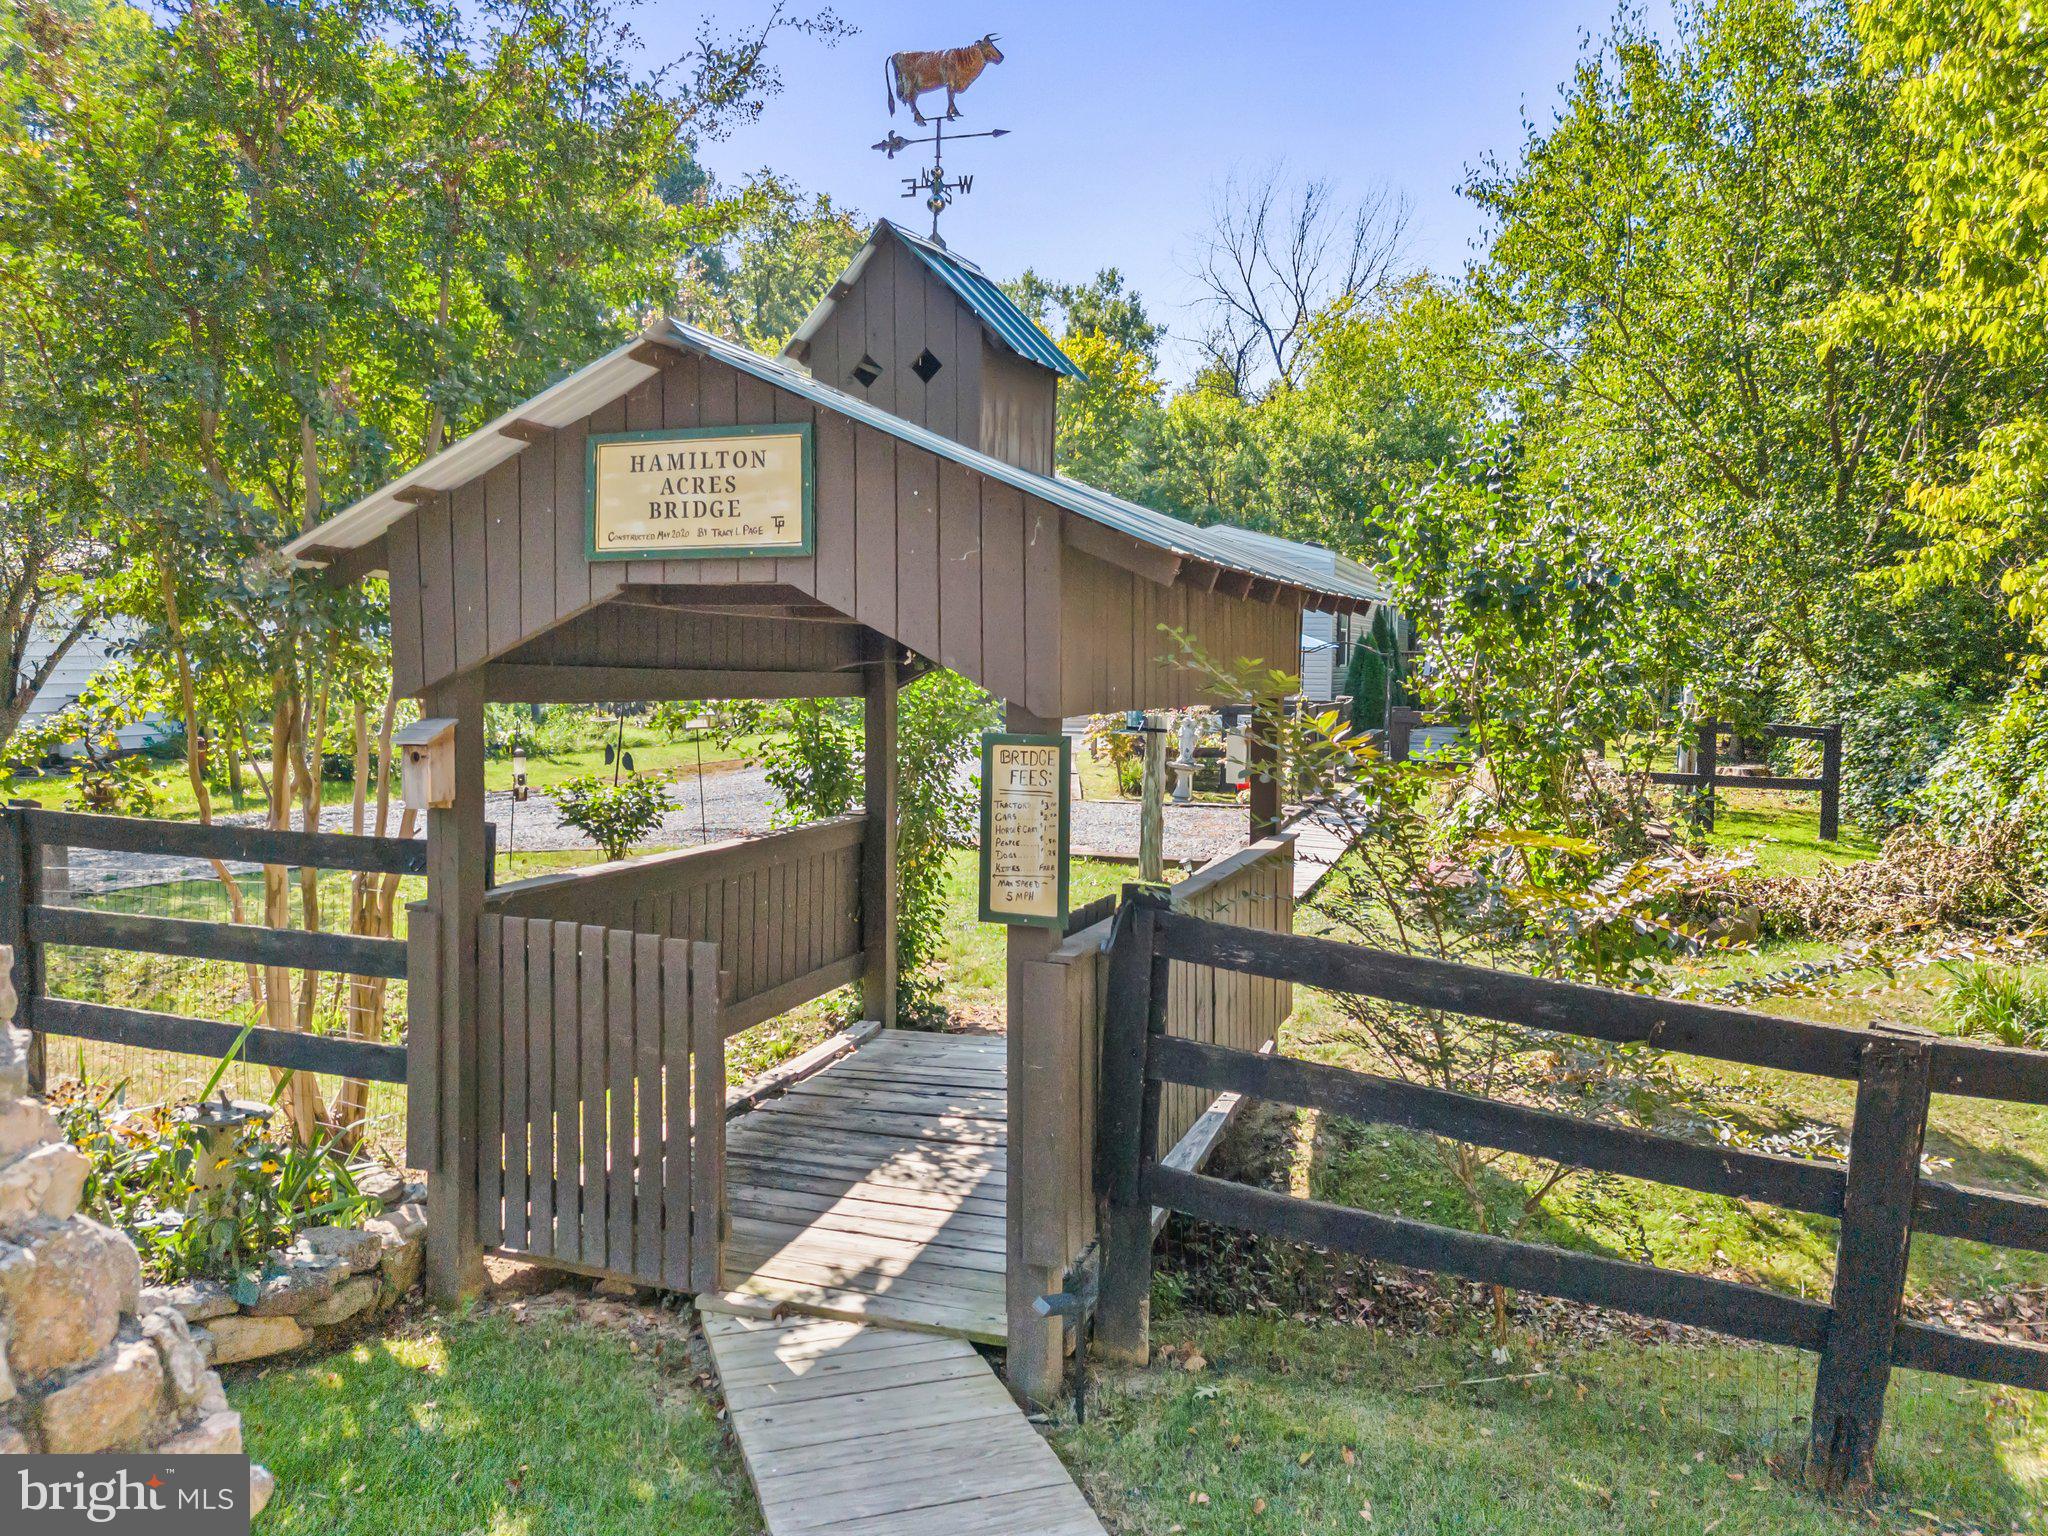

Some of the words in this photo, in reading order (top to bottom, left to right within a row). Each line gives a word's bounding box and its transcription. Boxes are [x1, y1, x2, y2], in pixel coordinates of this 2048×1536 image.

[958, 174, 974, 195] W
[630, 449, 768, 473] HAMILTON
[659, 475, 737, 496] ACRES
[648, 499, 741, 520] BRIDGE
[671, 528, 690, 539] 2020
[696, 527, 708, 538] BY
[743, 524, 764, 536] PAGE
[1000, 749, 1056, 767] BRIDGE
[1010, 769, 1052, 787] FEES:
[994, 811, 1018, 822] CARS
[1015, 891, 1035, 902] MPH
